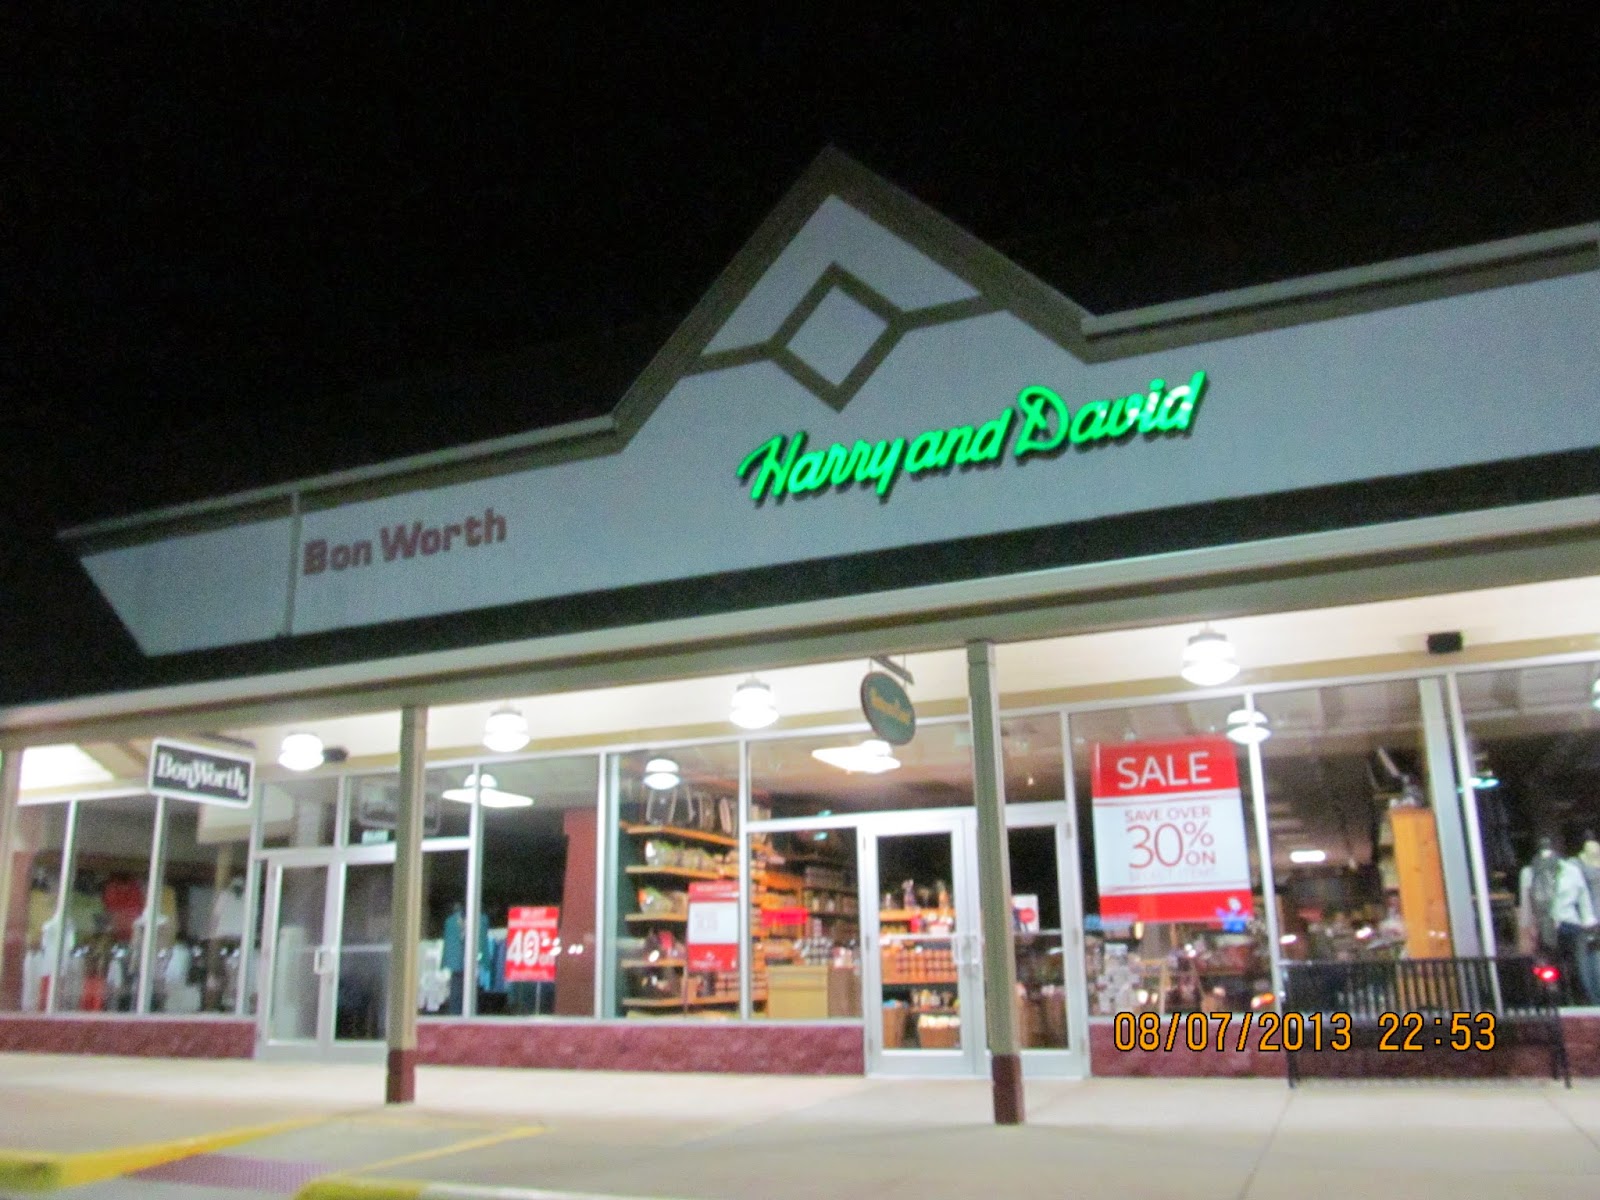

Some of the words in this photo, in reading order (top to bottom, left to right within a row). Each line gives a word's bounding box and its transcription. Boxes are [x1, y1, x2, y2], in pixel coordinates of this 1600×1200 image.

[737, 431, 905, 500] Harry
[903, 408, 1014, 473] and
[1014, 371, 1206, 456] David
[303, 538, 373, 576] Bon
[379, 507, 507, 562] Worth
[1116, 751, 1212, 789] SALE
[1125, 809, 1163, 823] SAVE
[1167, 805, 1211, 820] OVER
[1126, 822, 1214, 868] 30%
[1185, 851, 1216, 865] ON
